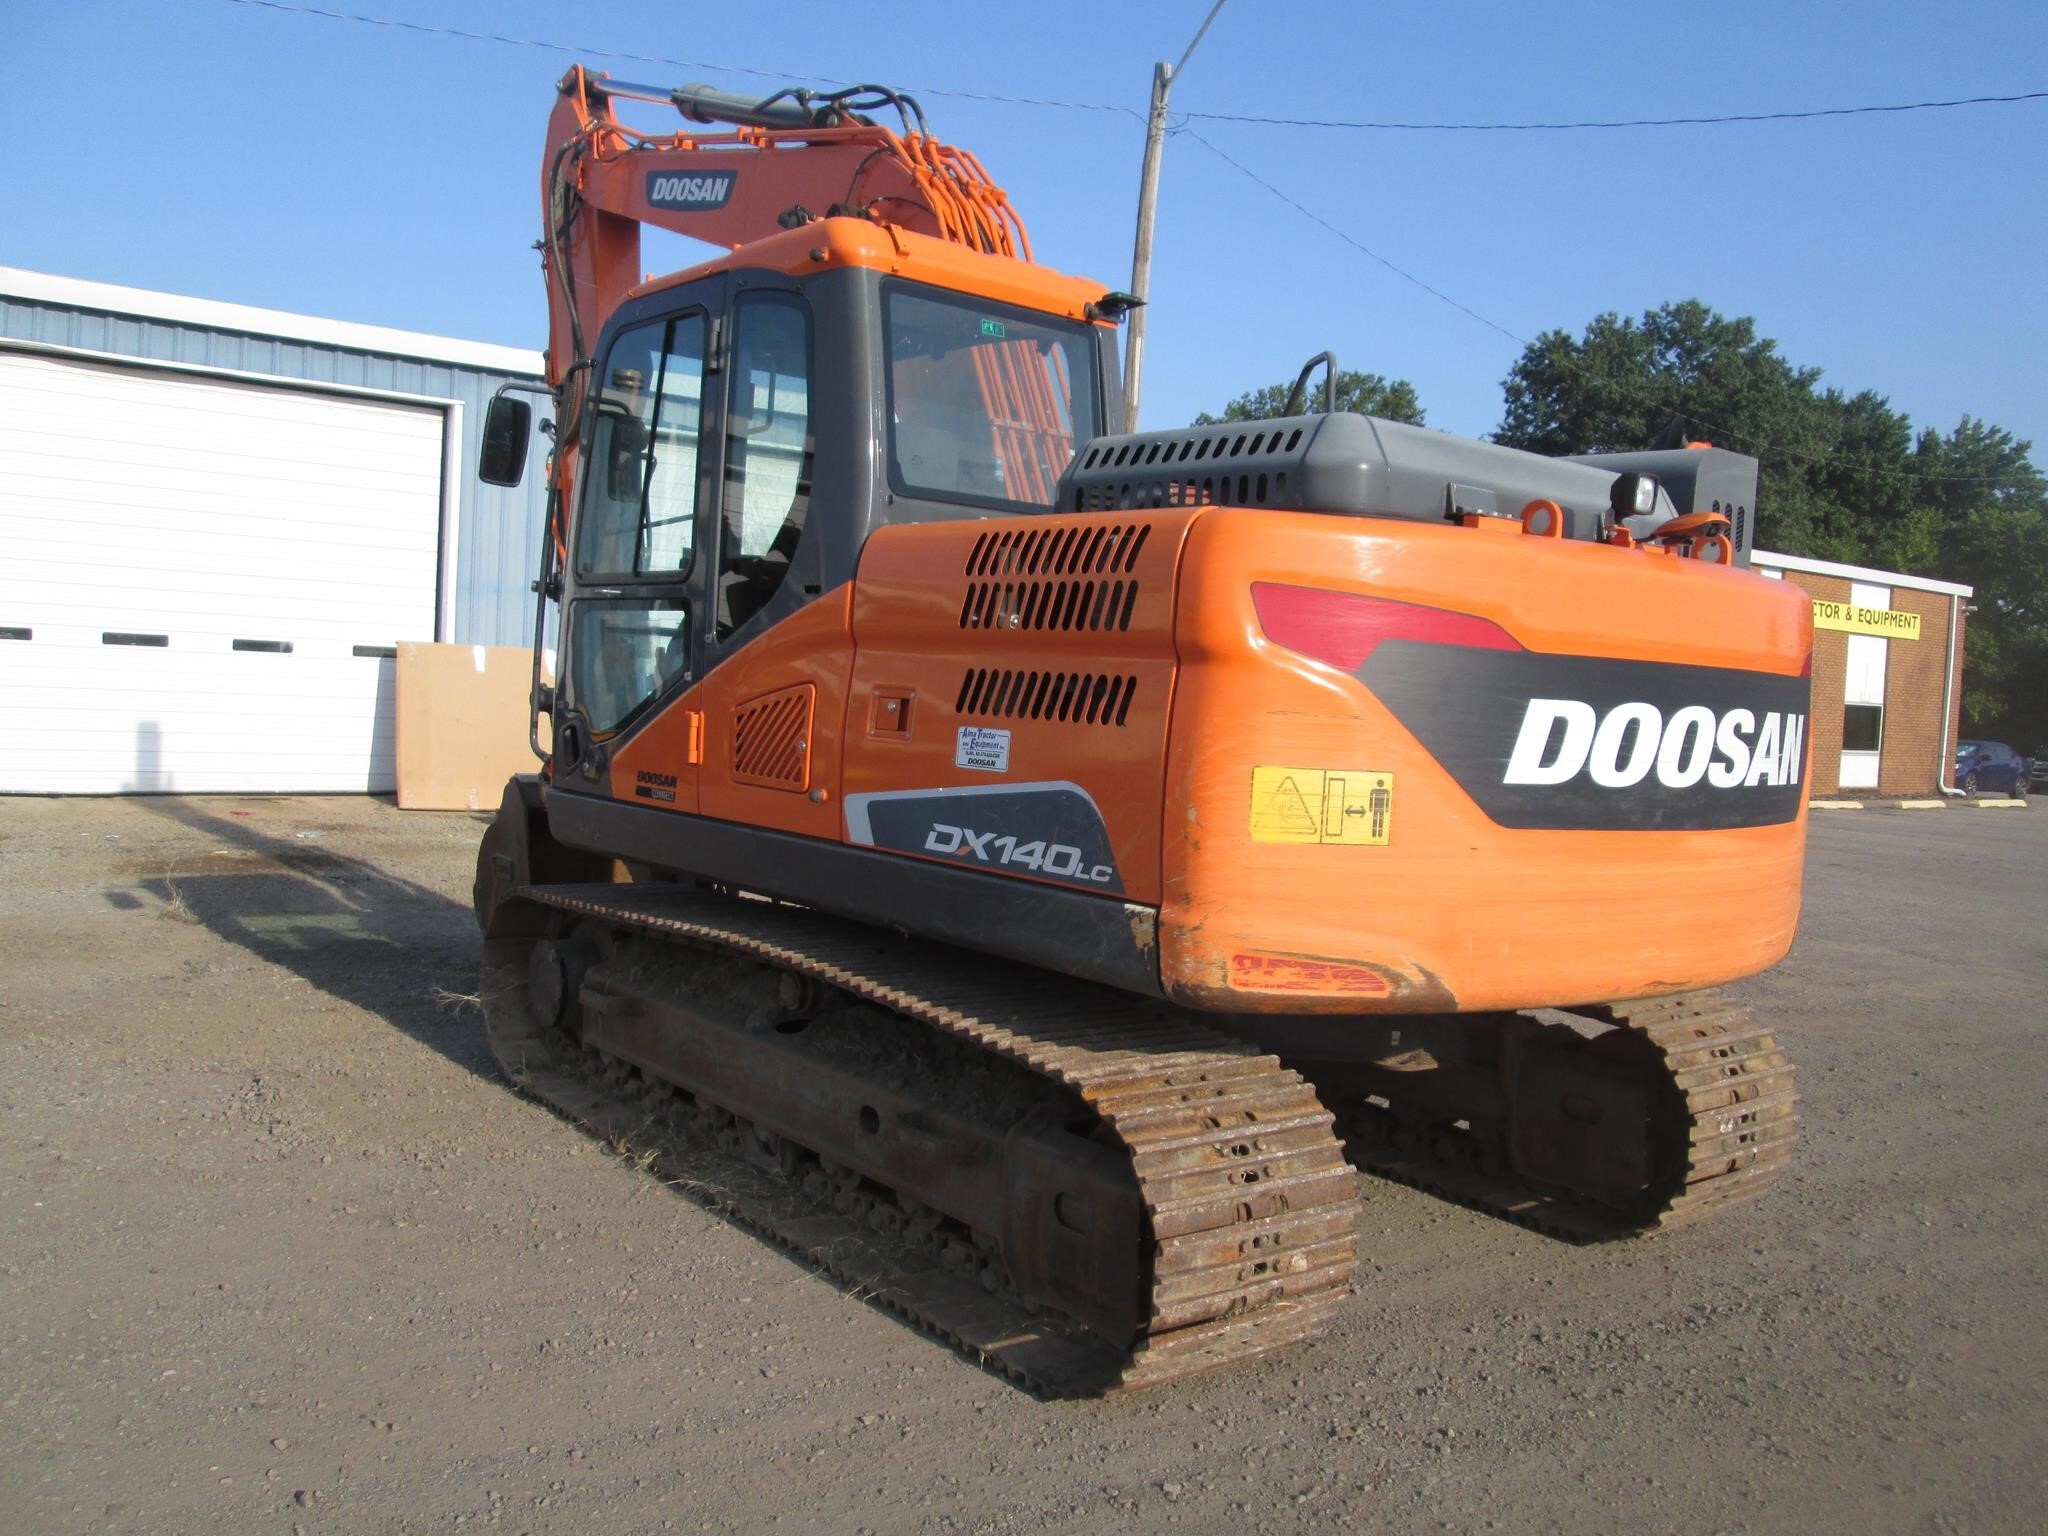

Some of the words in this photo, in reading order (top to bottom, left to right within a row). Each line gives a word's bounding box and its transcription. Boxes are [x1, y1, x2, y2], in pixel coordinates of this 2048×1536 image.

[652, 178, 729, 201] DOOSAN
[1845, 606, 1853, 622] &
[1858, 607, 1919, 630] EQUIPMENT
[977, 728, 997, 740] Tractor
[970, 737, 1000, 750] Equipment
[1502, 698, 1805, 788] DOOSAN
[967, 757, 997, 767] DOOSAN
[637, 771, 678, 788] DOOSAN
